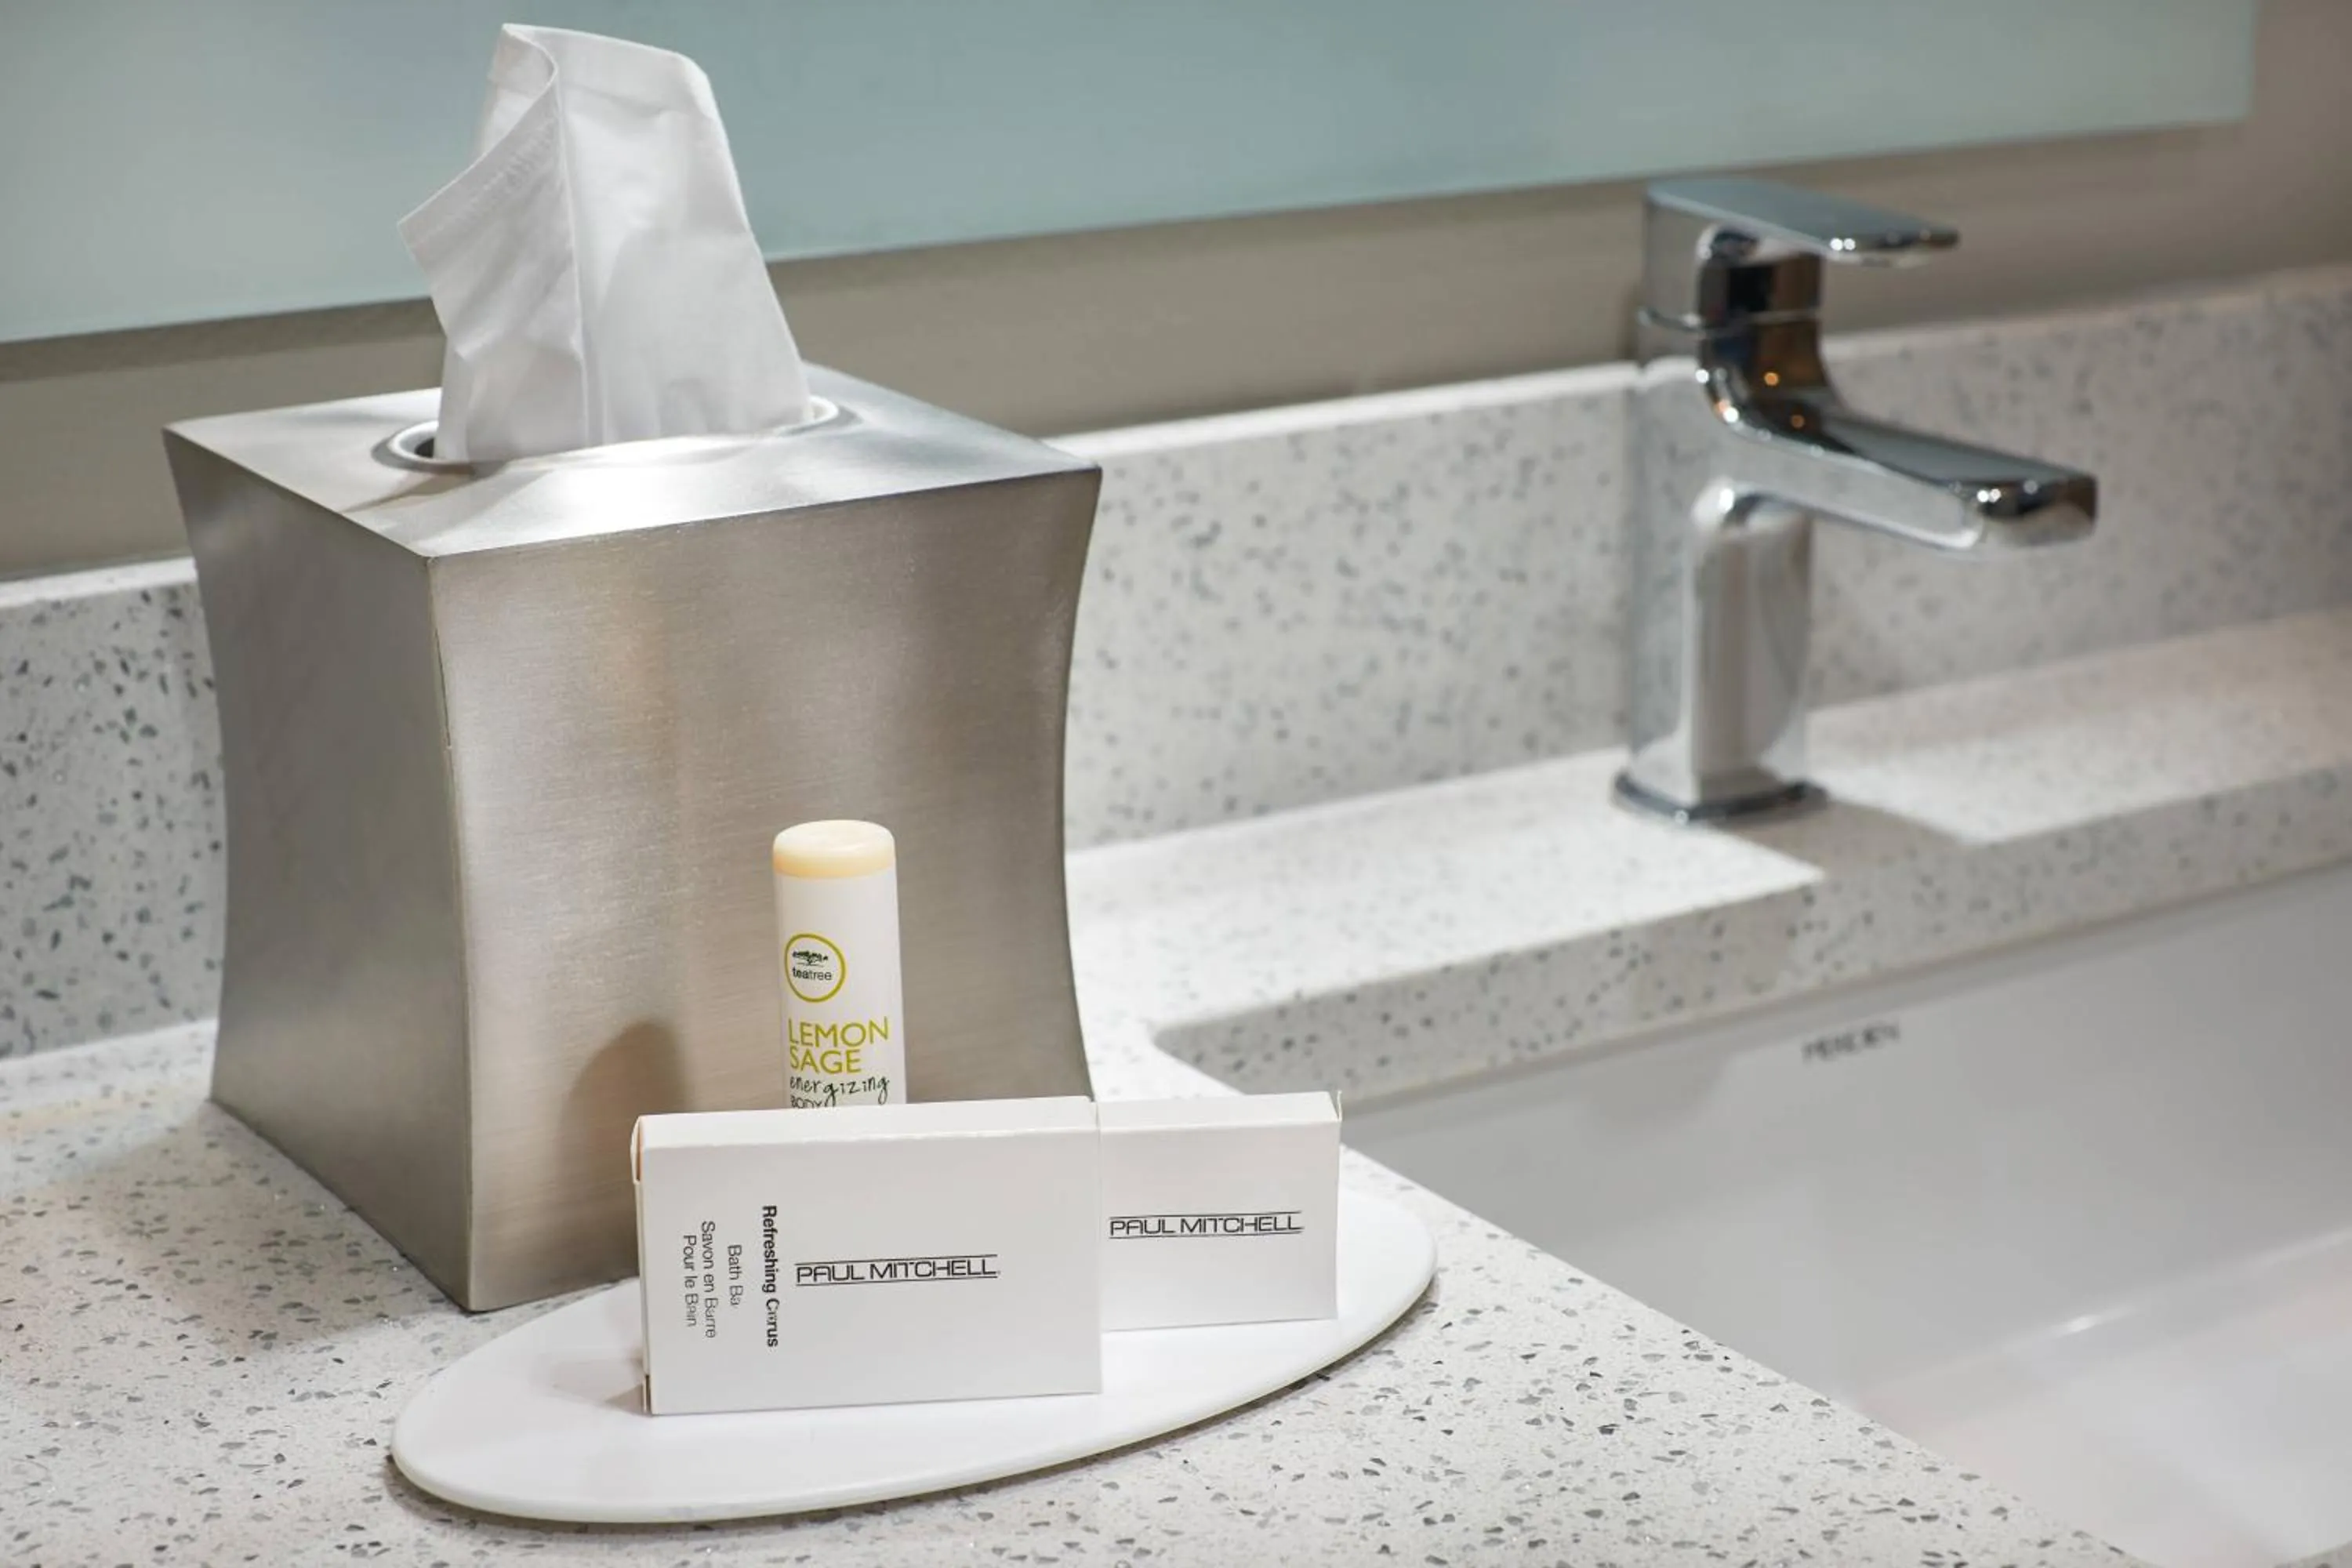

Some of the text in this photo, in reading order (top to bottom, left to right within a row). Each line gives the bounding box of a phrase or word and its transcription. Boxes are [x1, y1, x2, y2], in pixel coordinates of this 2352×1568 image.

[792, 967, 833, 981] teatree
[788, 1017, 888, 1047] LEMON
[789, 1047, 862, 1074] SAGE
[789, 1076, 890, 1108] energizing
[1109, 1215, 1304, 1236] PAUL MITCHELL
[683, 1235, 697, 1271] Pour
[702, 1221, 716, 1269] Savon
[762, 1206, 779, 1294] Refreshing
[728, 1245, 742, 1280] Bath
[797, 1259, 996, 1283] PAUL MITCHELL
[684, 1276, 698, 1289] le
[703, 1274, 714, 1293] en
